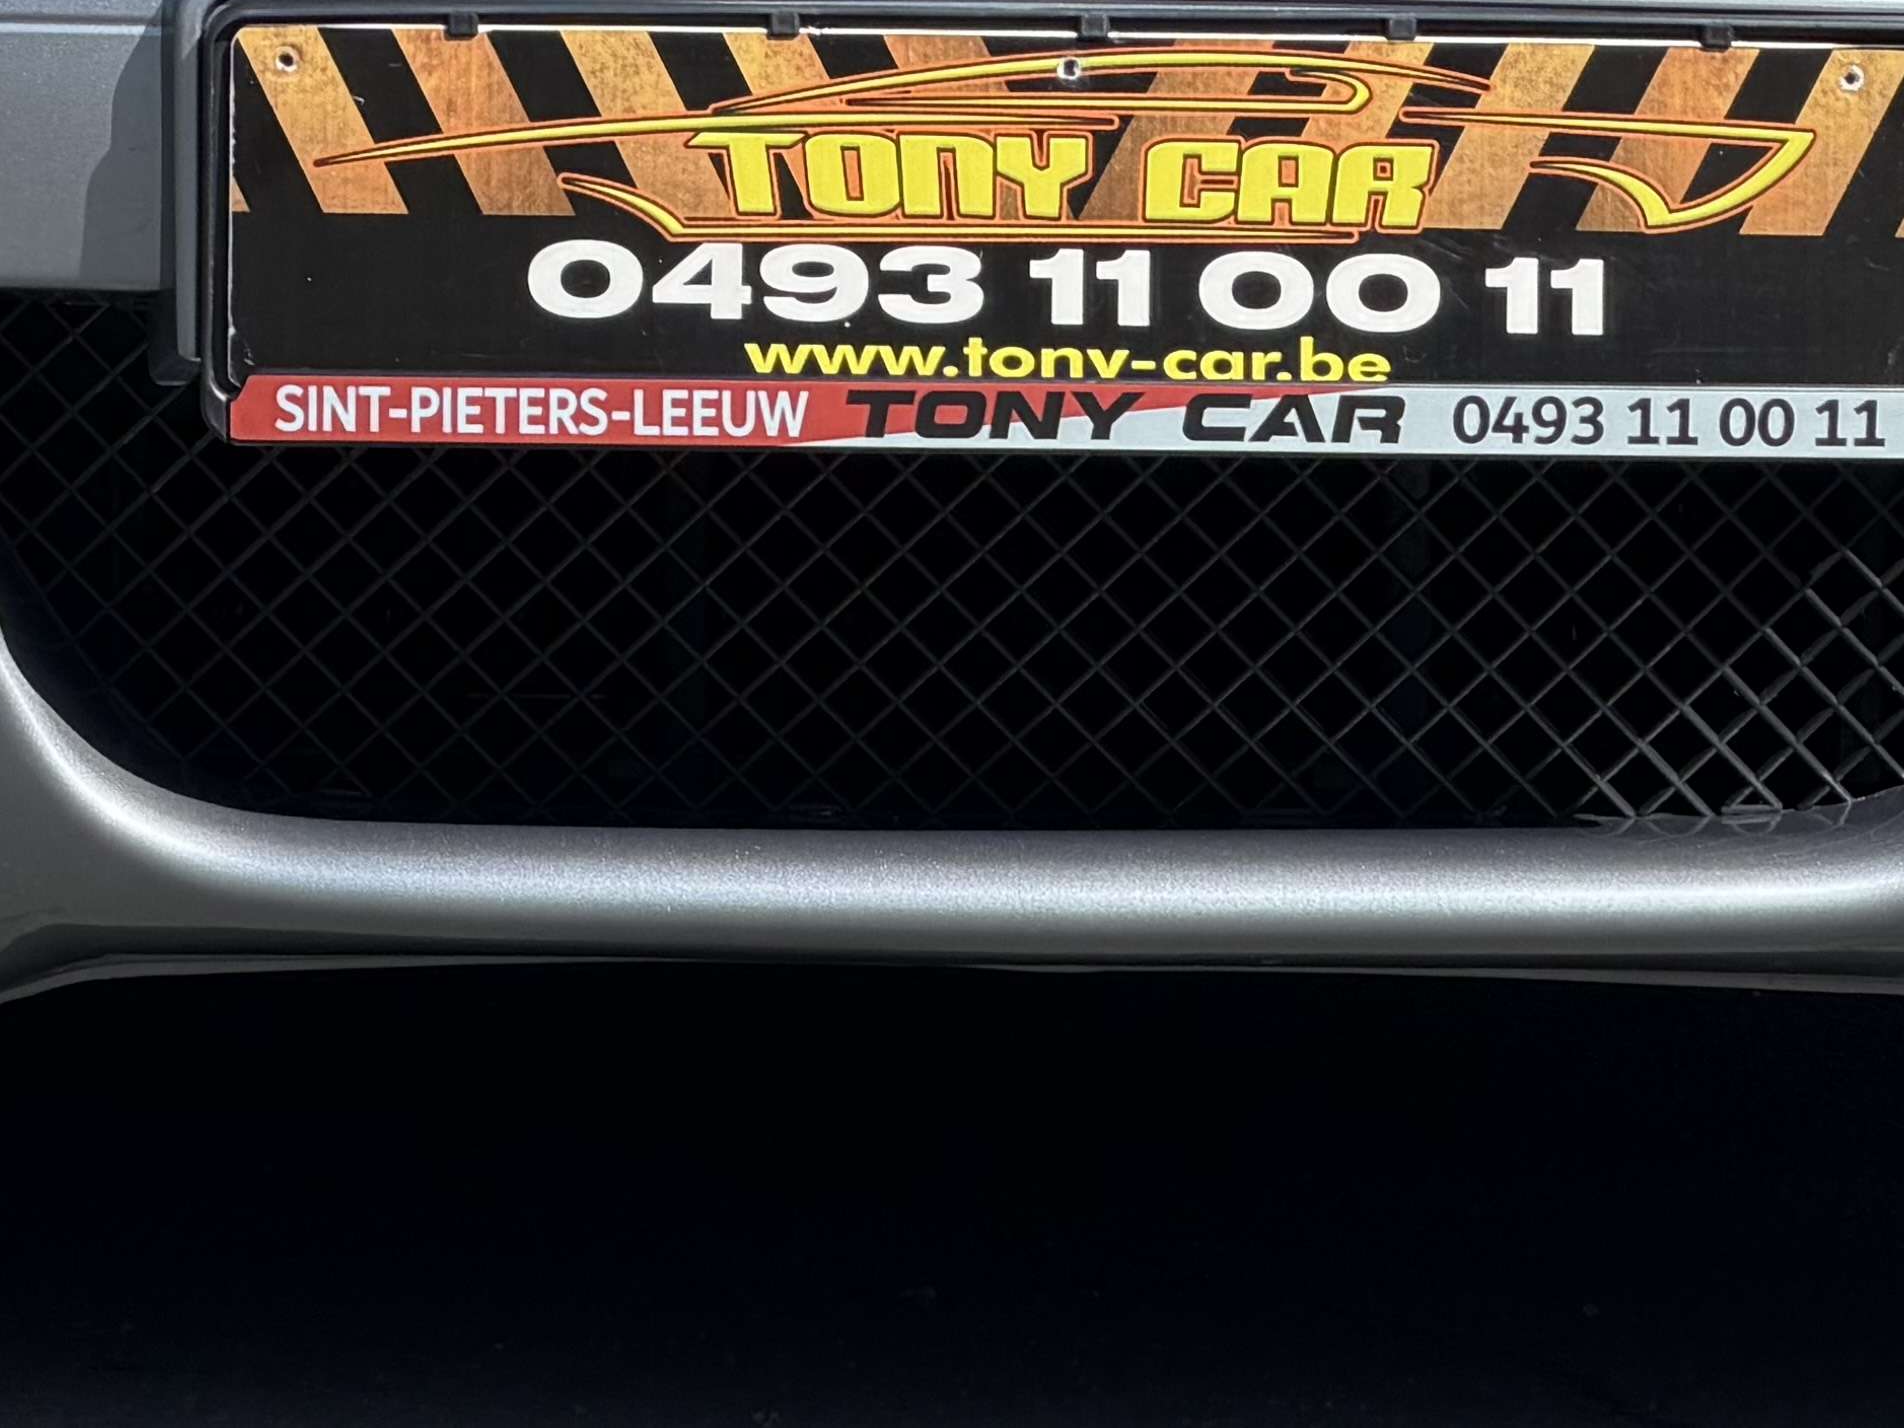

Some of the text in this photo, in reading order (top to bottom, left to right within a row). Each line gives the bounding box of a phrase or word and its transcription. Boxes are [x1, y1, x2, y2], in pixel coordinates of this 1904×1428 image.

[683, 129, 1439, 231] TONY CAR
[527, 239, 1605, 336] 0493 11 00 11
[274, 384, 1886, 447] SINT-PIETERS-LEEUW TONY CAR 0493 11 00 11
